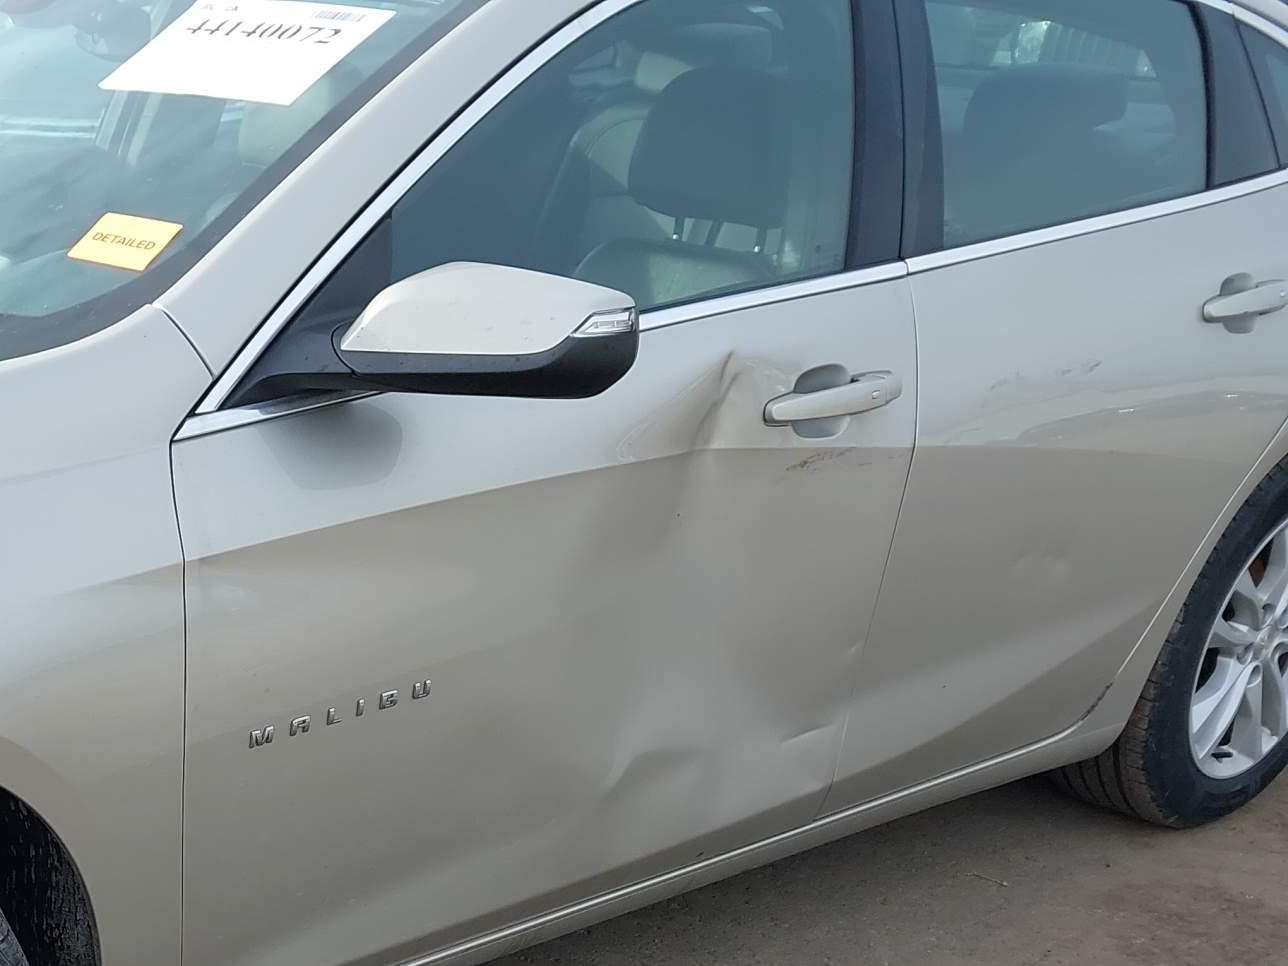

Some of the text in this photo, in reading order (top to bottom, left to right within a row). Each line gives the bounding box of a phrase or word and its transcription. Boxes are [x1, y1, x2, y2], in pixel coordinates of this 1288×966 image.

[186, 18, 343, 45] 44140072
[91, 231, 156, 250] DETAILED
[248, 679, 432, 749] MALIBU
